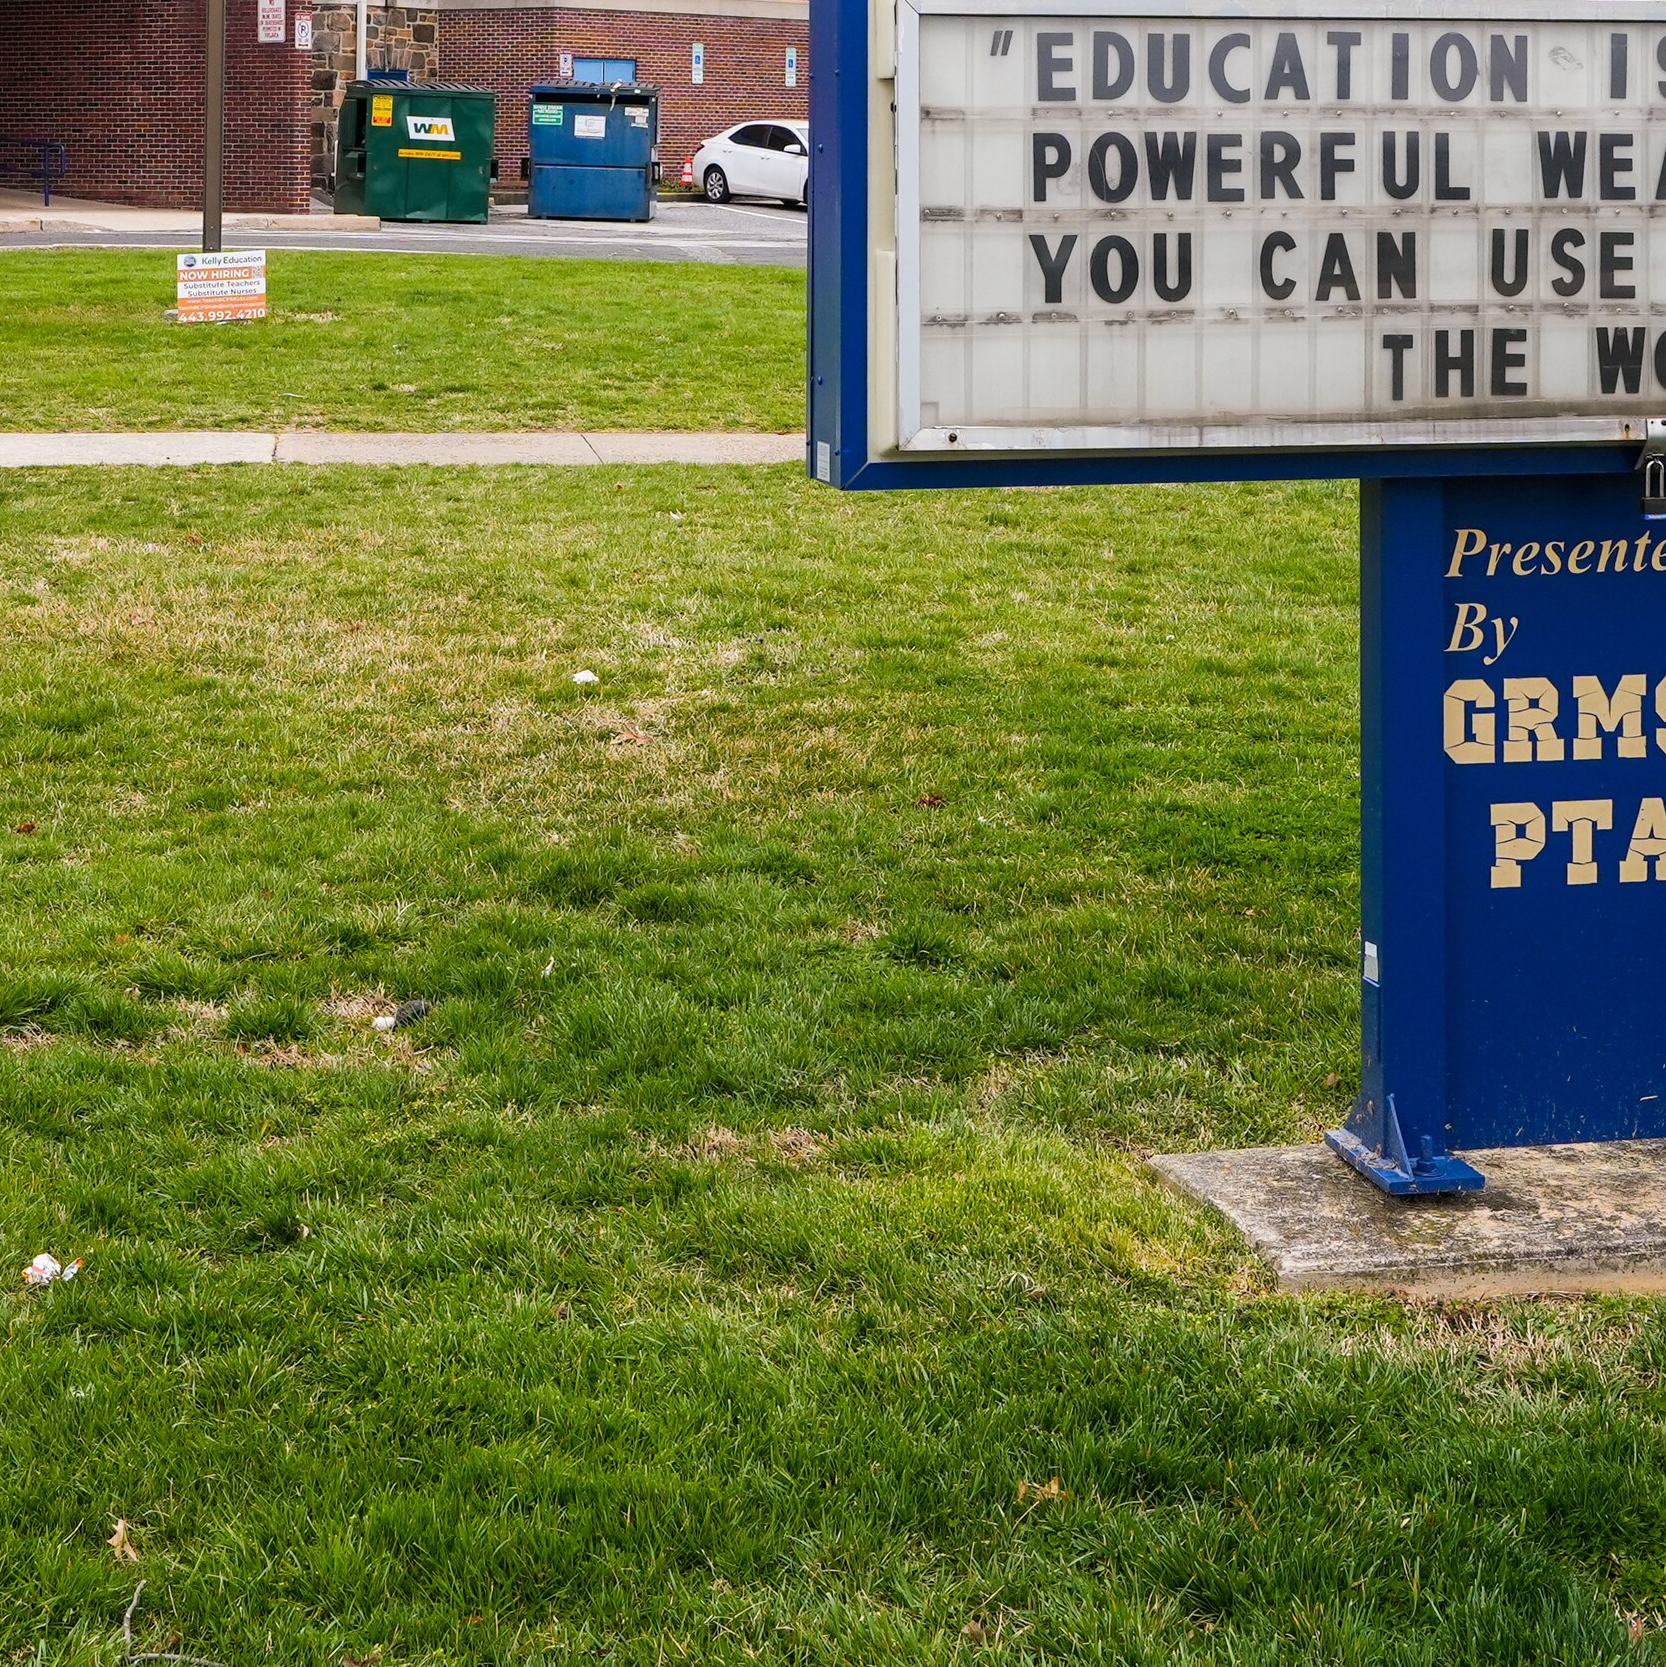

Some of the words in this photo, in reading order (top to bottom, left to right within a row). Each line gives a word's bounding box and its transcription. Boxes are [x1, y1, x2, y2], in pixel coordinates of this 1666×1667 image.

[414, 123, 449, 135] WM
[1031, 130, 1472, 204] POWERFUL
[180, 271, 208, 280] NOW
[211, 269, 249, 279] HIRING
[202, 257, 222, 266] Kelly
[223, 256, 262, 264] Education
[1028, 232, 1193, 305] YOU
[1259, 230, 1418, 302] CAN
[1491, 227, 1636, 300] USE
[178, 308, 266, 323] 443.992.4210
[1382, 328, 1528, 402] THE
[1443, 602, 1520, 666] By
